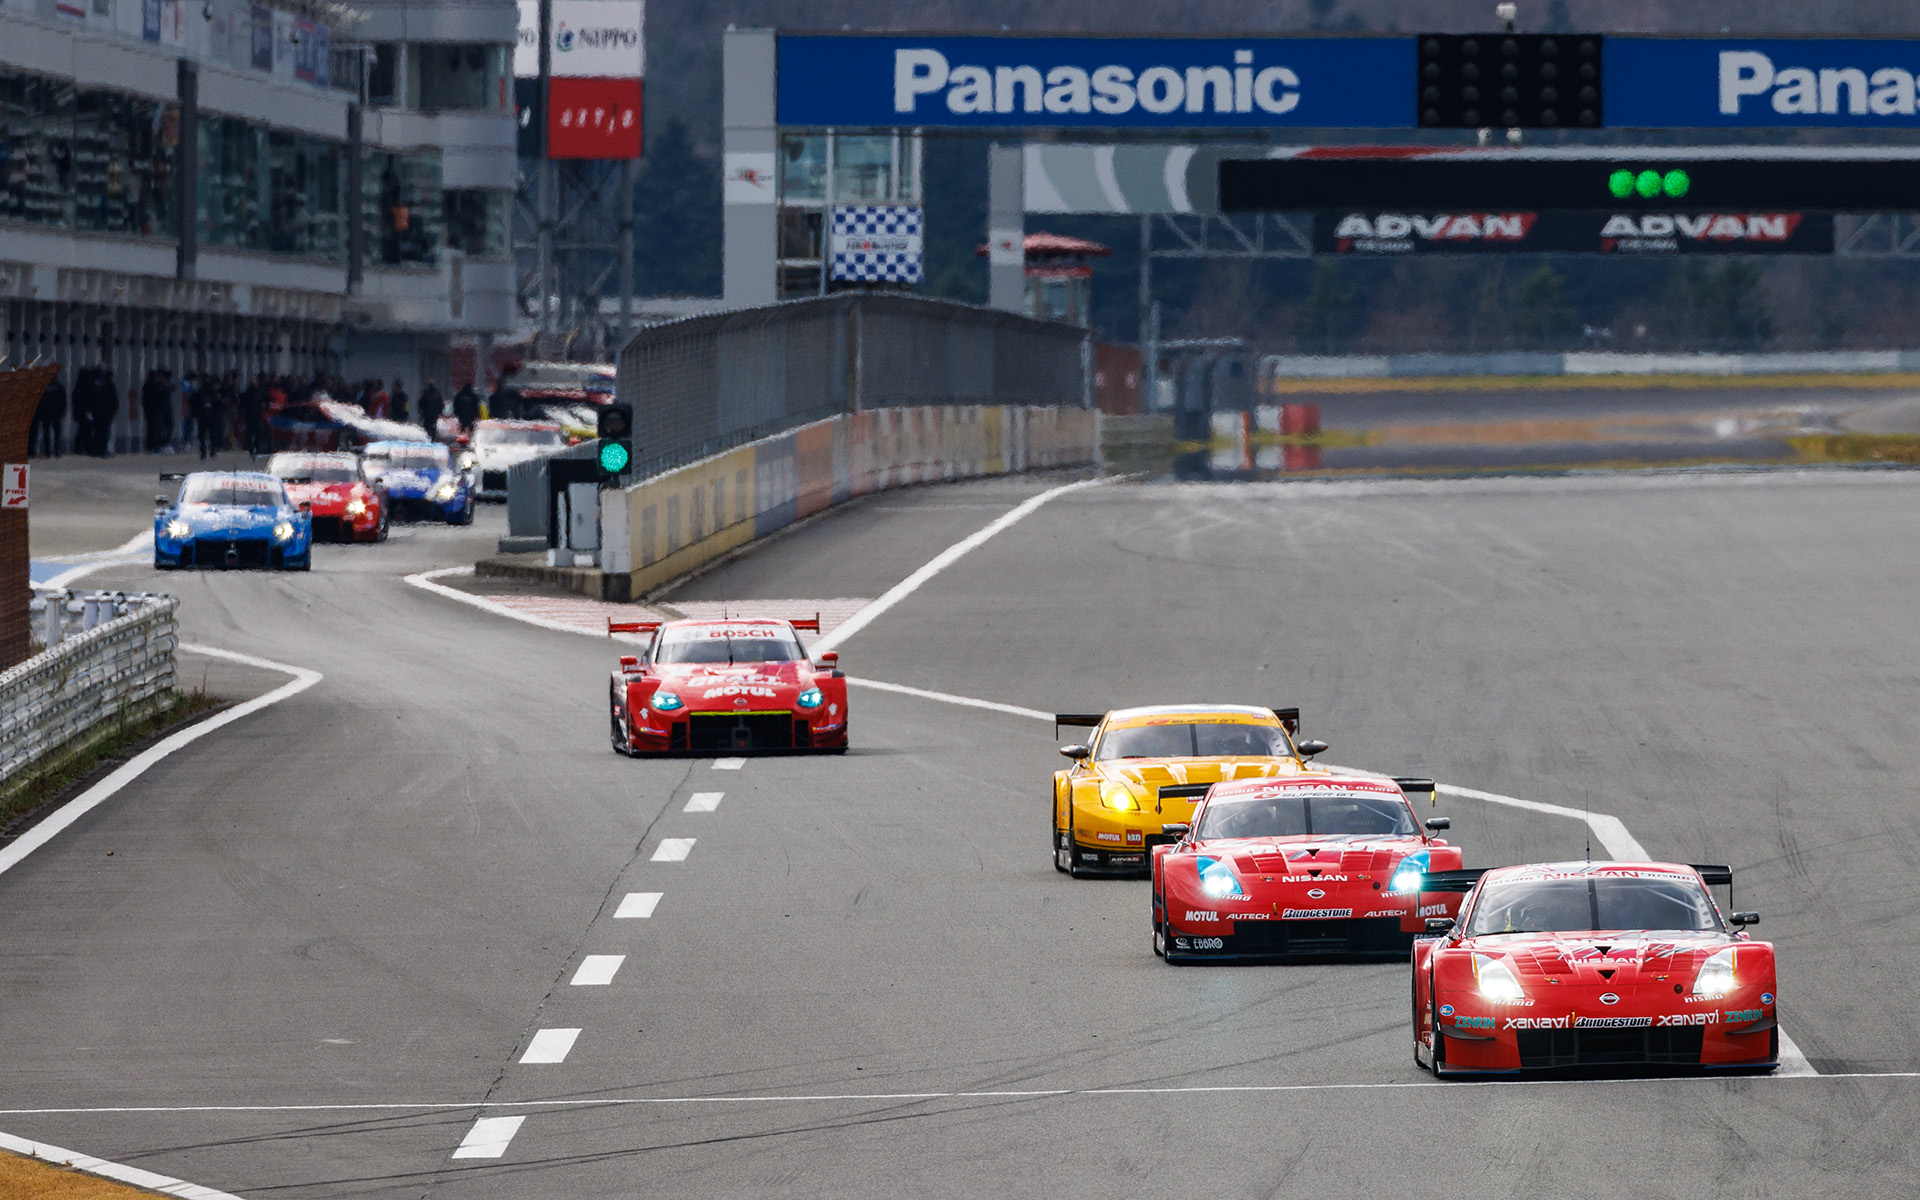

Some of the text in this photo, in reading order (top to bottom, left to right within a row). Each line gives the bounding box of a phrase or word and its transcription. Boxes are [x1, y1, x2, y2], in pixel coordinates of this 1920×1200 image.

[578, 27, 637, 48] NIPPO
[894, 47, 1300, 114] Panasonic
[1718, 50, 1920, 115] Pana
[1334, 213, 1525, 239] ADVAN
[1600, 213, 1788, 238] ADVAN
[709, 629, 776, 638] BOSCH
[703, 685, 776, 699] MOTUL
[1261, 784, 1347, 792] NISSAN
[1097, 832, 1121, 842] MOTUL
[1282, 874, 1348, 882] NISSAN
[1543, 871, 1640, 880] NISSAN
[1185, 910, 1219, 922] MOTUL
[1282, 908, 1352, 919] BRIDGESTONE
[1364, 909, 1407, 917] AUTECH
[1568, 956, 1643, 964] NISSAN
[1454, 1016, 1495, 1029] ZENRIN
[1574, 1016, 1652, 1028] BRIDGESTONE
[1725, 1009, 1763, 1023] ZENRIN
